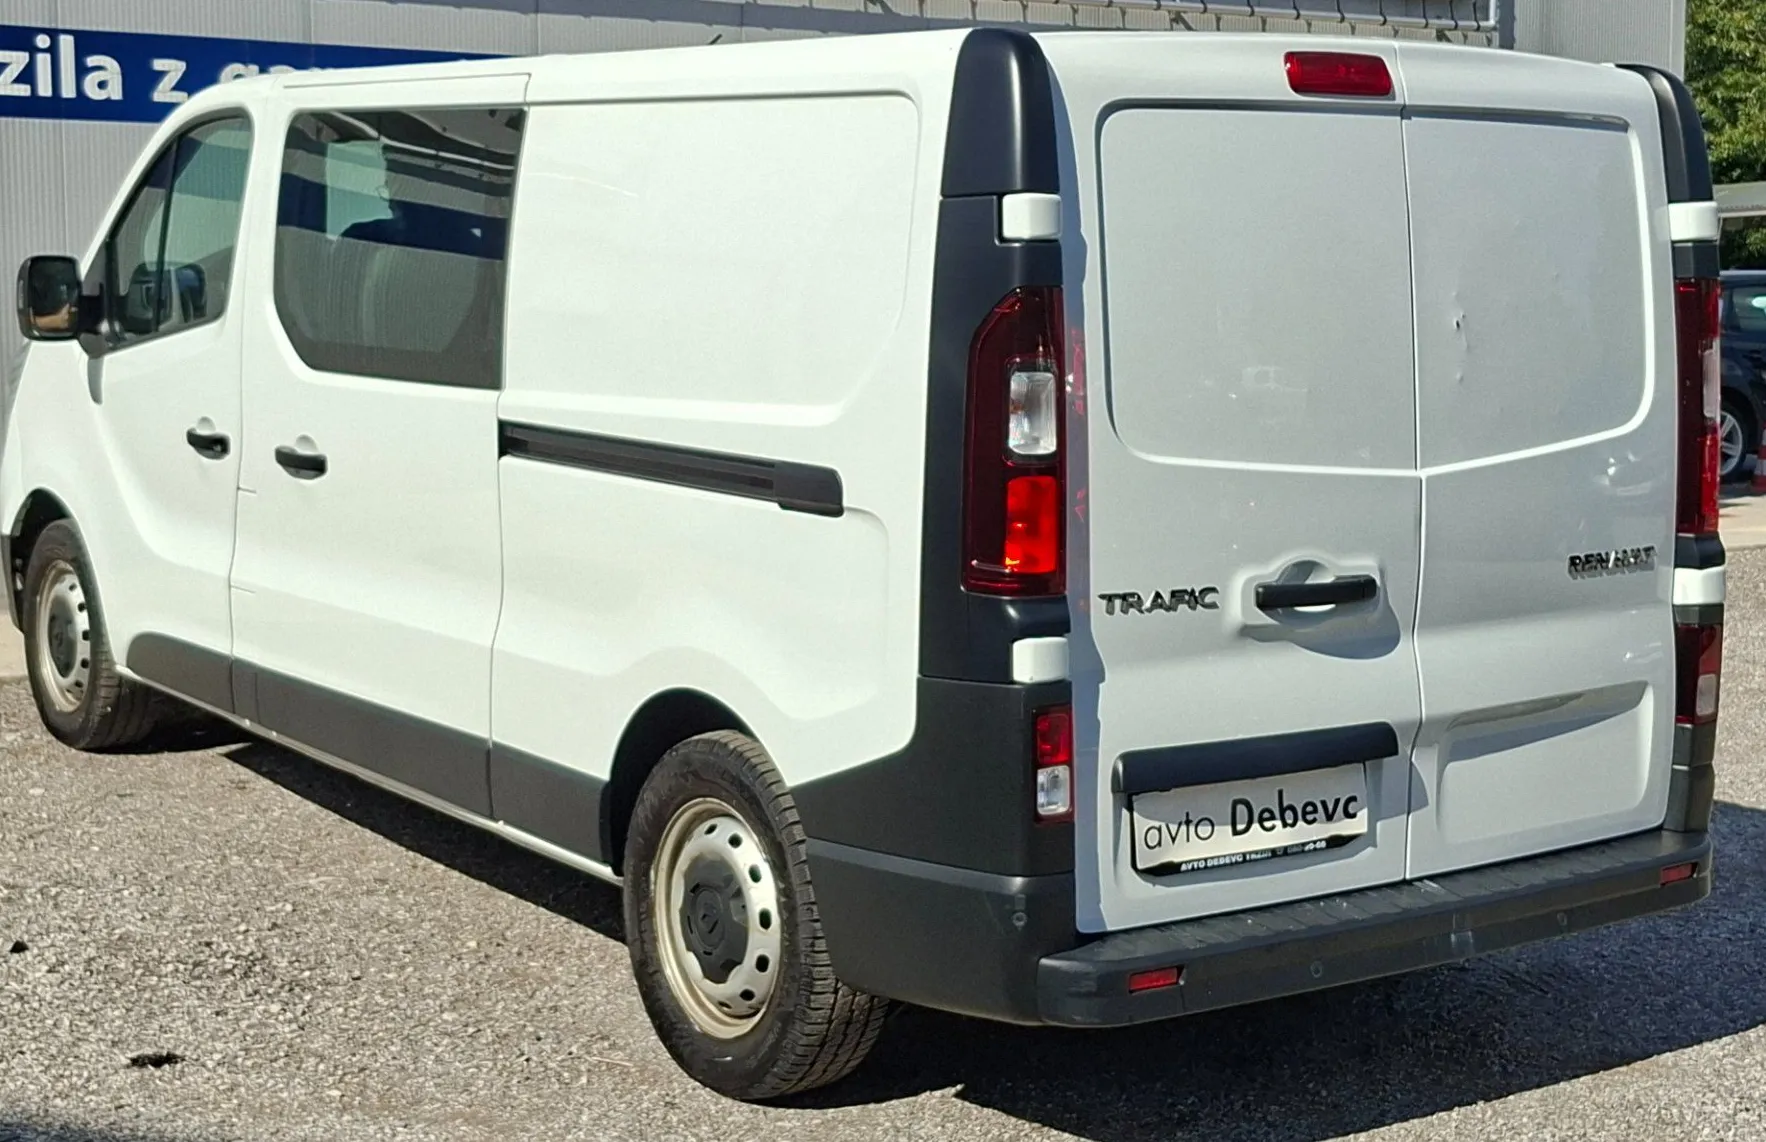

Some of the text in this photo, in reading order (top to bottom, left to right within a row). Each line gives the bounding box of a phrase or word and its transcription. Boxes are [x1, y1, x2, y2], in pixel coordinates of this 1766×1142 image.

[1097, 586, 1220, 616] TRAFIC
[1143, 788, 1358, 850] avto Debevc
[1180, 857, 1206, 871] AVTO
